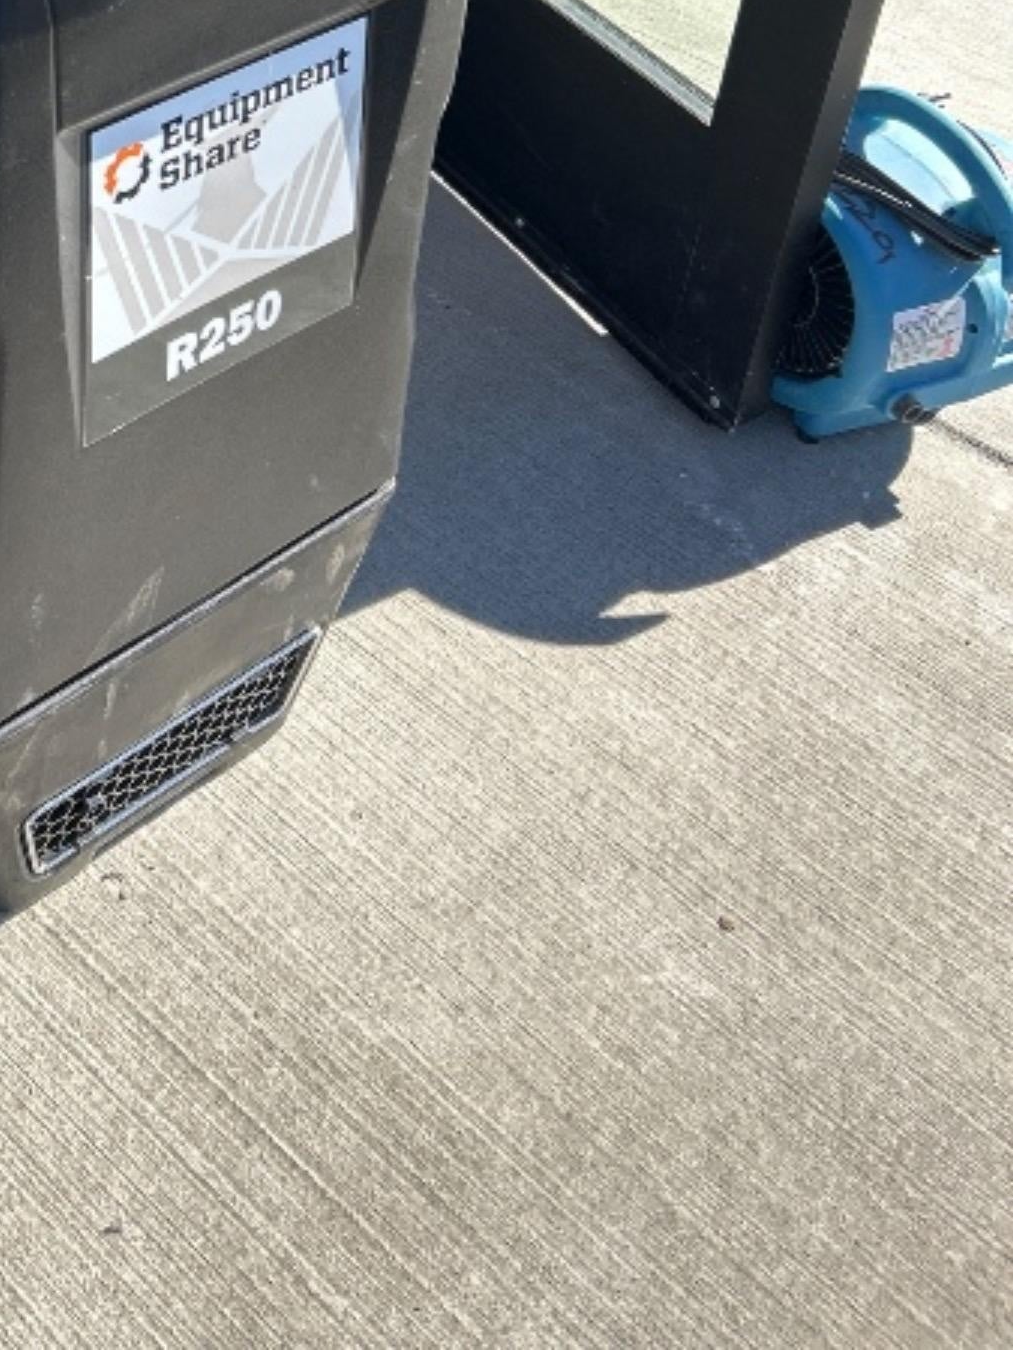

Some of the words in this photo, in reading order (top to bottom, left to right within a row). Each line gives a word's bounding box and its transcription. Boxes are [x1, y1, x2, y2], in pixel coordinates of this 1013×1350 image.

[160, 47, 351, 153] Equipment
[159, 125, 263, 192] Share
[165, 290, 282, 382] R250
